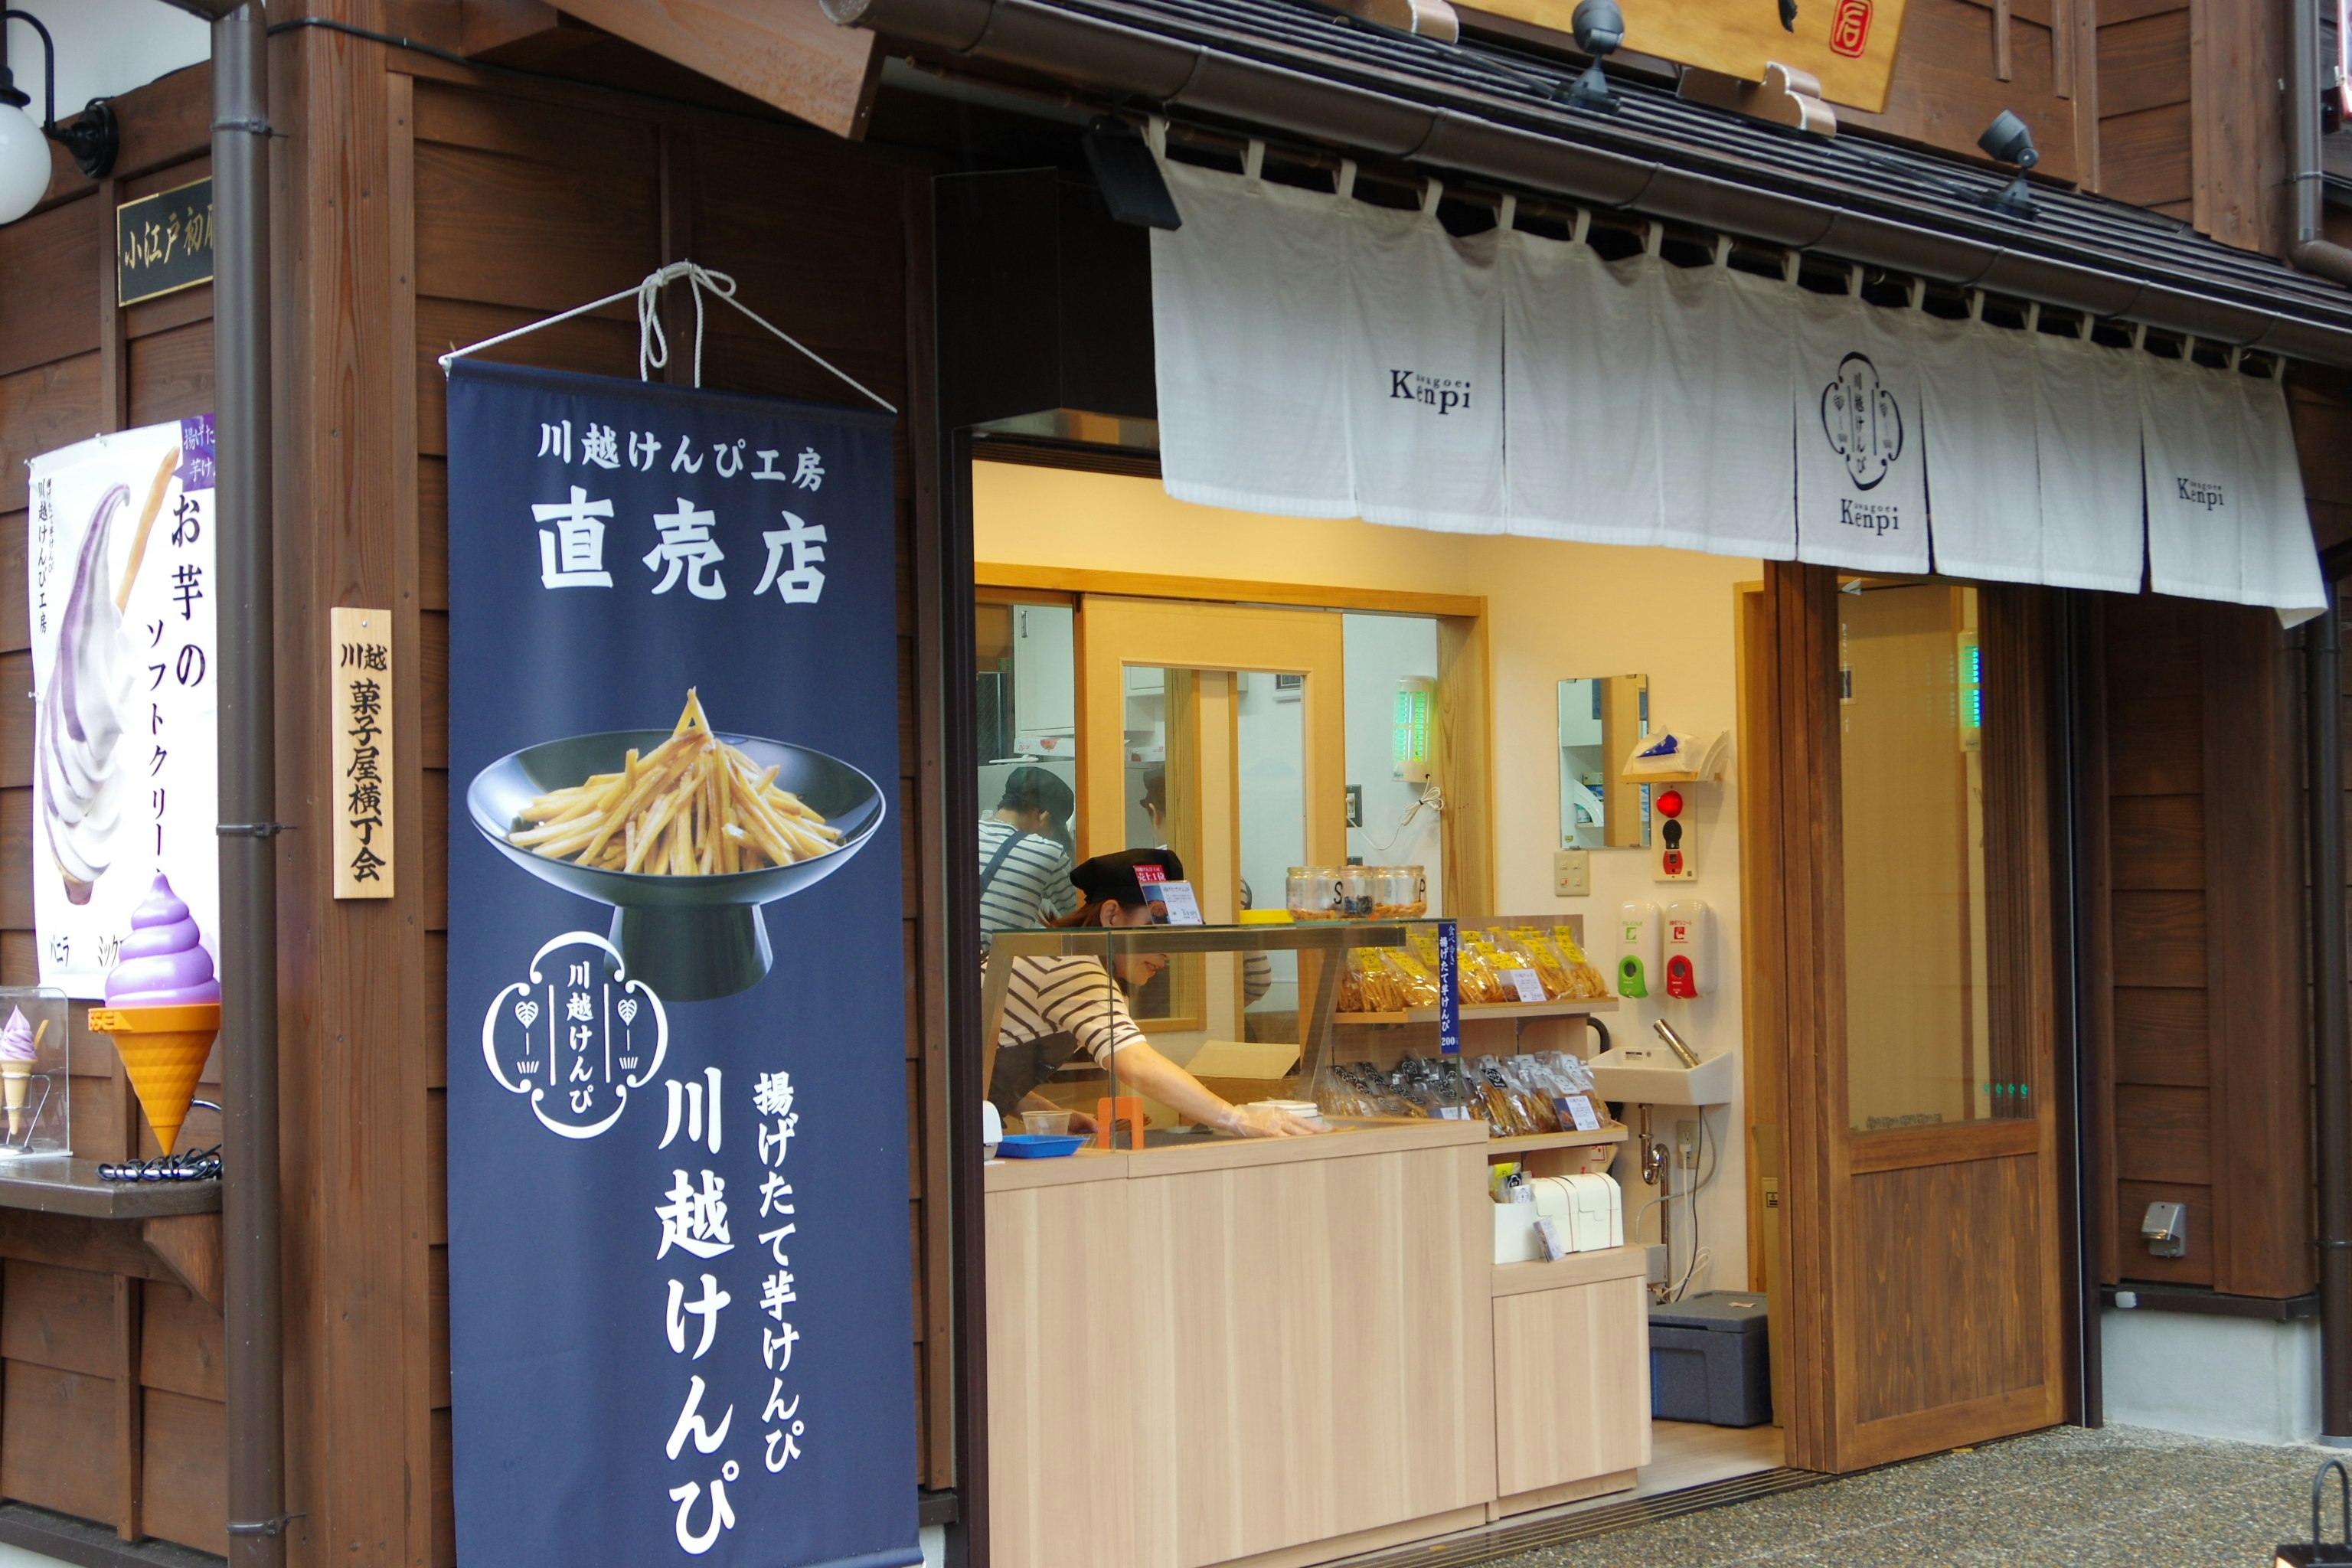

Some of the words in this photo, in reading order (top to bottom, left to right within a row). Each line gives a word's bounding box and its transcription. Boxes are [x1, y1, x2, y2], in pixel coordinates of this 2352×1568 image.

[1390, 369, 1471, 414] Kenpi
[189, 456, 215, 482] 芋け
[537, 419, 825, 492] 川越けんぴ工房
[2177, 477, 2224, 511] Kenpi
[38, 478, 47, 635] 川越けんぴ工房
[531, 485, 828, 604] 直売店
[1840, 498, 1900, 536] Kenpi
[171, 494, 206, 688] お芋の
[341, 642, 388, 671] 川越
[146, 619, 168, 872] ソフトクリー
[347, 678, 387, 883] 菓子屋横丁会
[97, 934, 123, 968] ミック
[566, 960, 595, 1115] 川越けんぴ
[654, 1066, 740, 1556] 川越けんぴ
[753, 1072, 805, 1475] 揚げたて芋けんぴ
